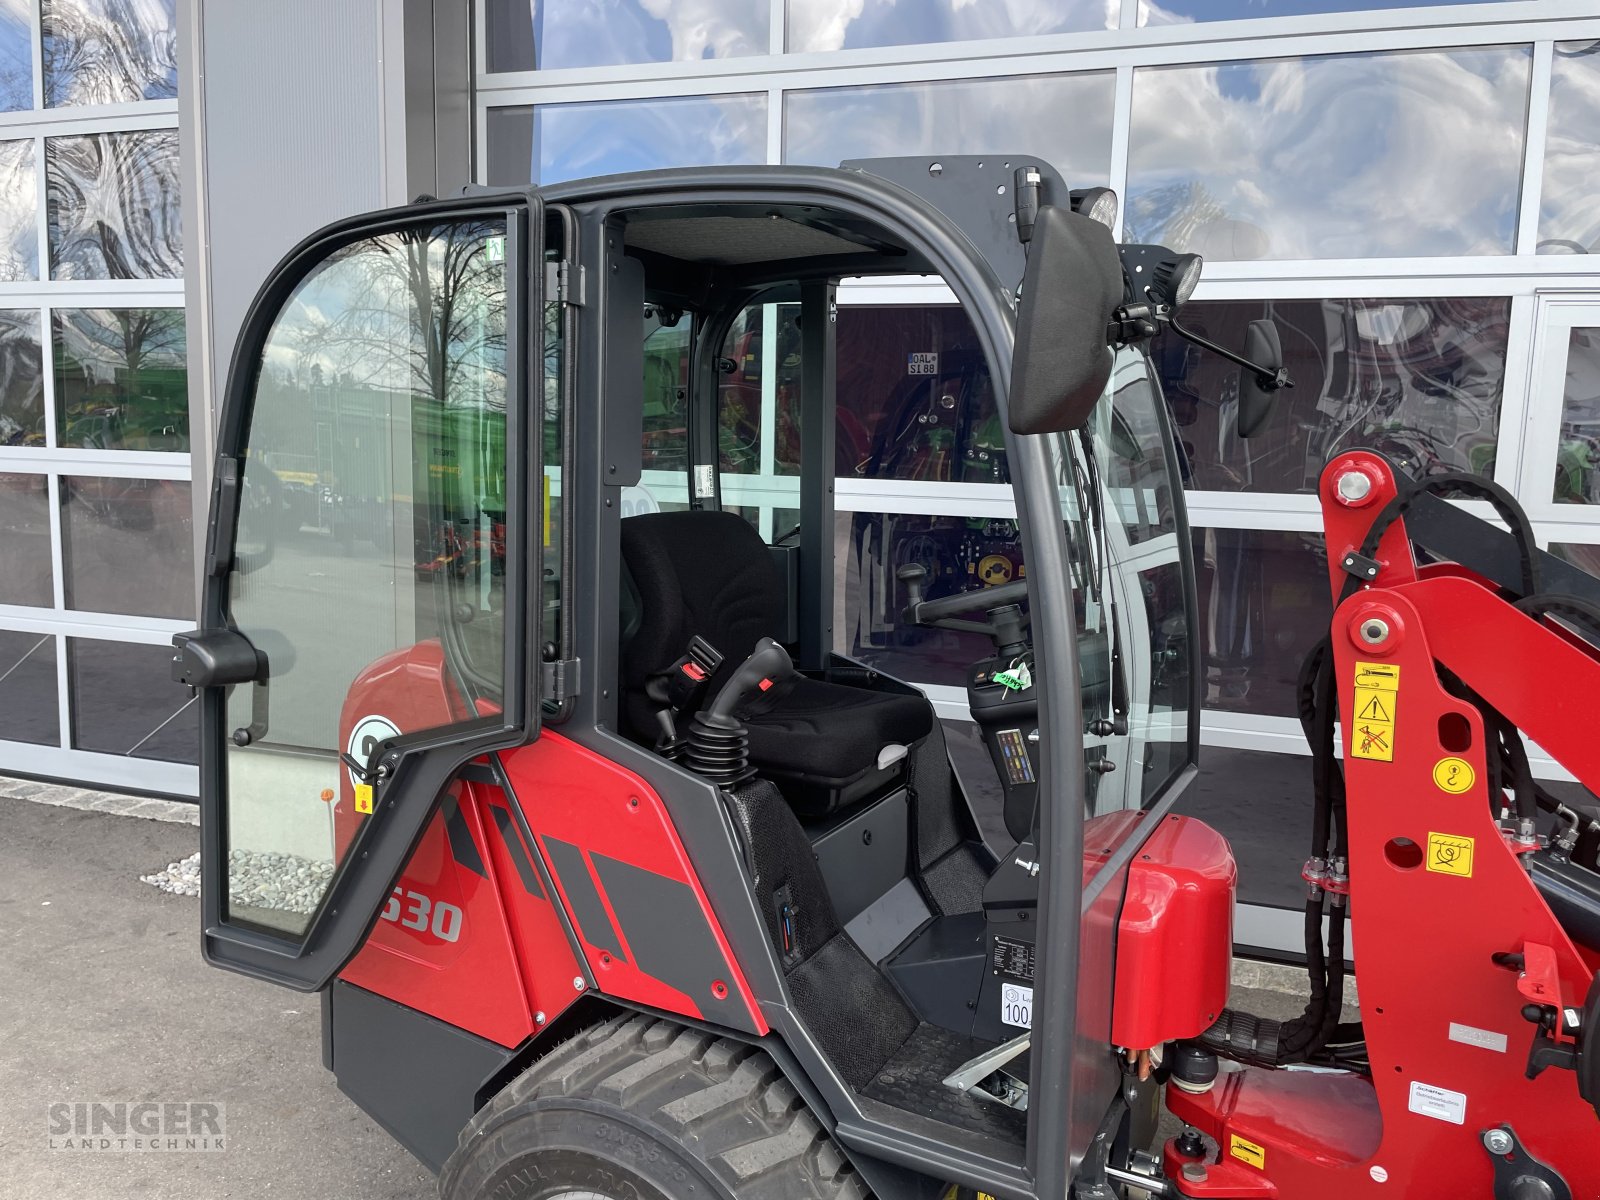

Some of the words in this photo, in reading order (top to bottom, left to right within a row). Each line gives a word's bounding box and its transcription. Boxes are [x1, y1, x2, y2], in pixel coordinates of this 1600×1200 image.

[912, 354, 931, 364] OAL
[923, 364, 935, 374] 88
[1005, 1003, 1028, 1025] 100
